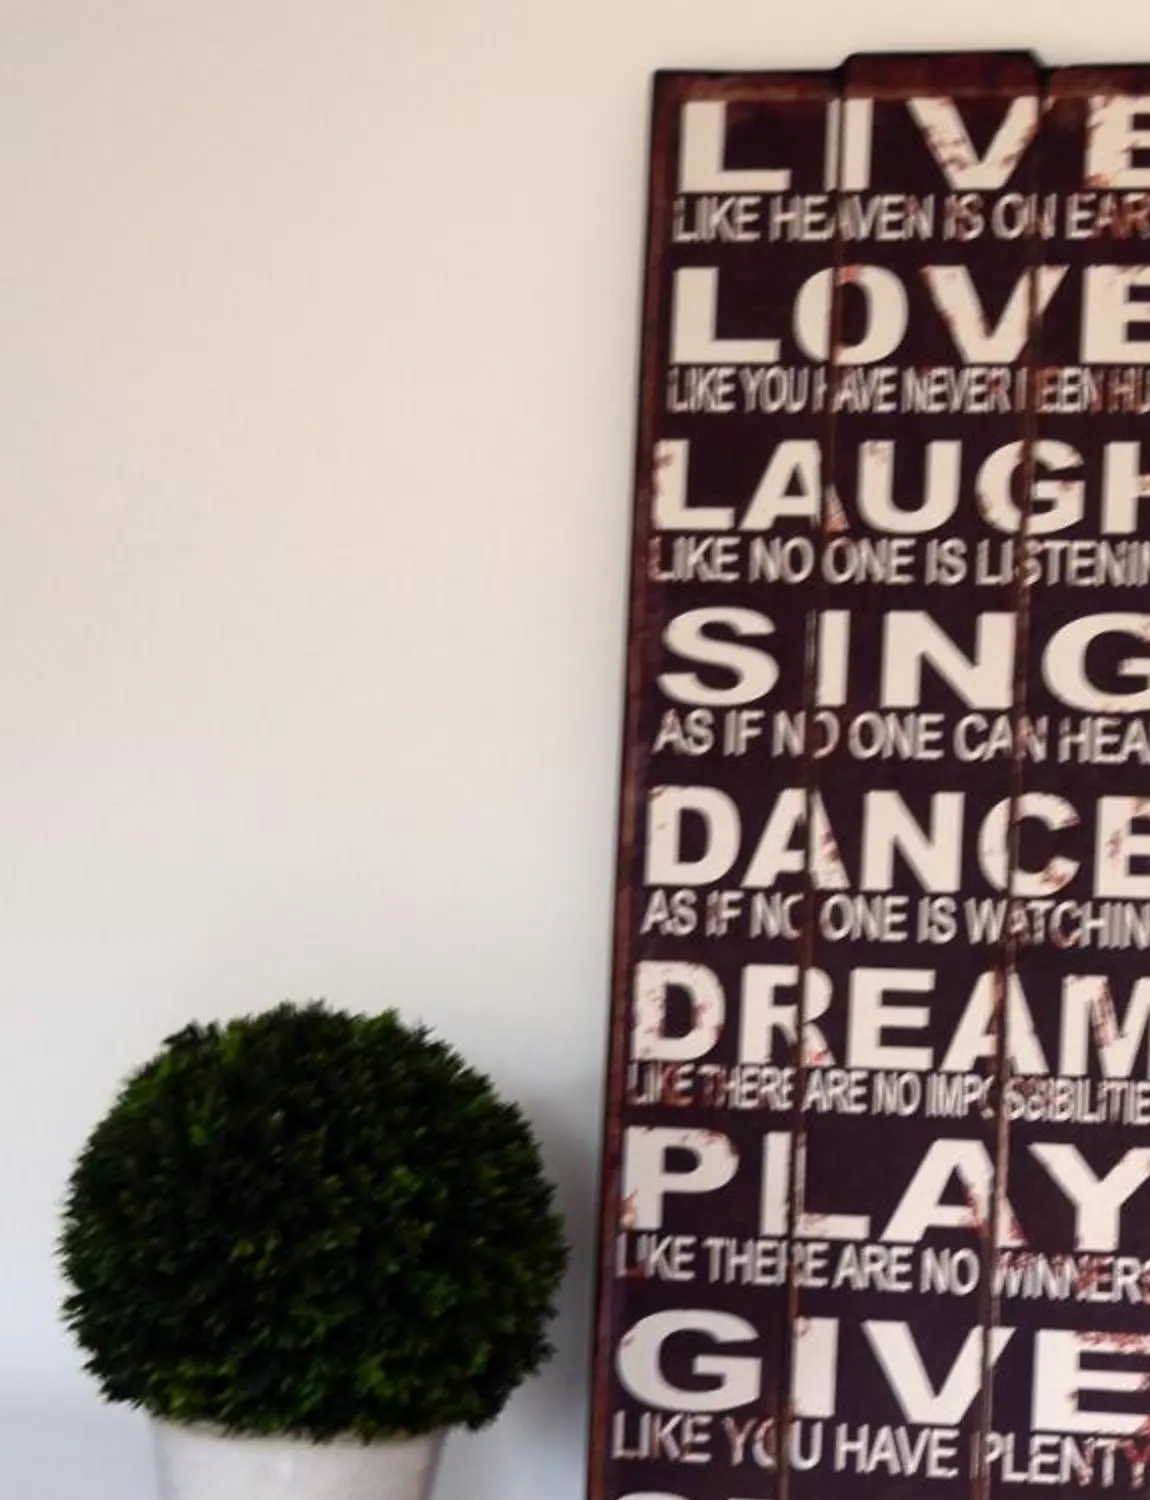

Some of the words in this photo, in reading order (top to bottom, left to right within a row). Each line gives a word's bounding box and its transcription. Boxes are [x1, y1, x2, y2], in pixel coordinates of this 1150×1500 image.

[672, 194, 762, 242] LIKE
[768, 194, 934, 242] HEAVEN
[942, 193, 985, 241] IS
[991, 192, 1057, 240] ON
[666, 365, 737, 414] LIKE
[739, 366, 809, 414] YOU
[900, 365, 1012, 414] NEVER
[649, 536, 742, 582] LIKE
[748, 536, 815, 582] NO
[820, 536, 916, 584] ONE
[923, 538, 969, 584] IS
[652, 708, 715, 756] AS
[722, 709, 766, 757] IF
[770, 711, 842, 759] NO
[847, 711, 945, 761] ONE
[952, 712, 1049, 764] CAN
[639, 888, 698, 937] AS
[705, 890, 745, 938] IF
[749, 892, 805, 939] NO
[818, 894, 908, 942] ONE
[917, 896, 958, 944] IS
[626, 1062, 696, 1107] LIKE
[698, 1064, 797, 1112] THERE
[800, 1068, 869, 1115] ARE
[871, 1071, 921, 1117] NO
[615, 1233, 697, 1282] LIKE
[702, 1236, 830, 1288] THERE
[831, 1243, 915, 1293] ARE
[919, 1247, 980, 1297] NO
[610, 1410, 713, 1463] LIKE
[723, 1416, 823, 1471] YOU
[834, 1422, 961, 1478] HAVE
